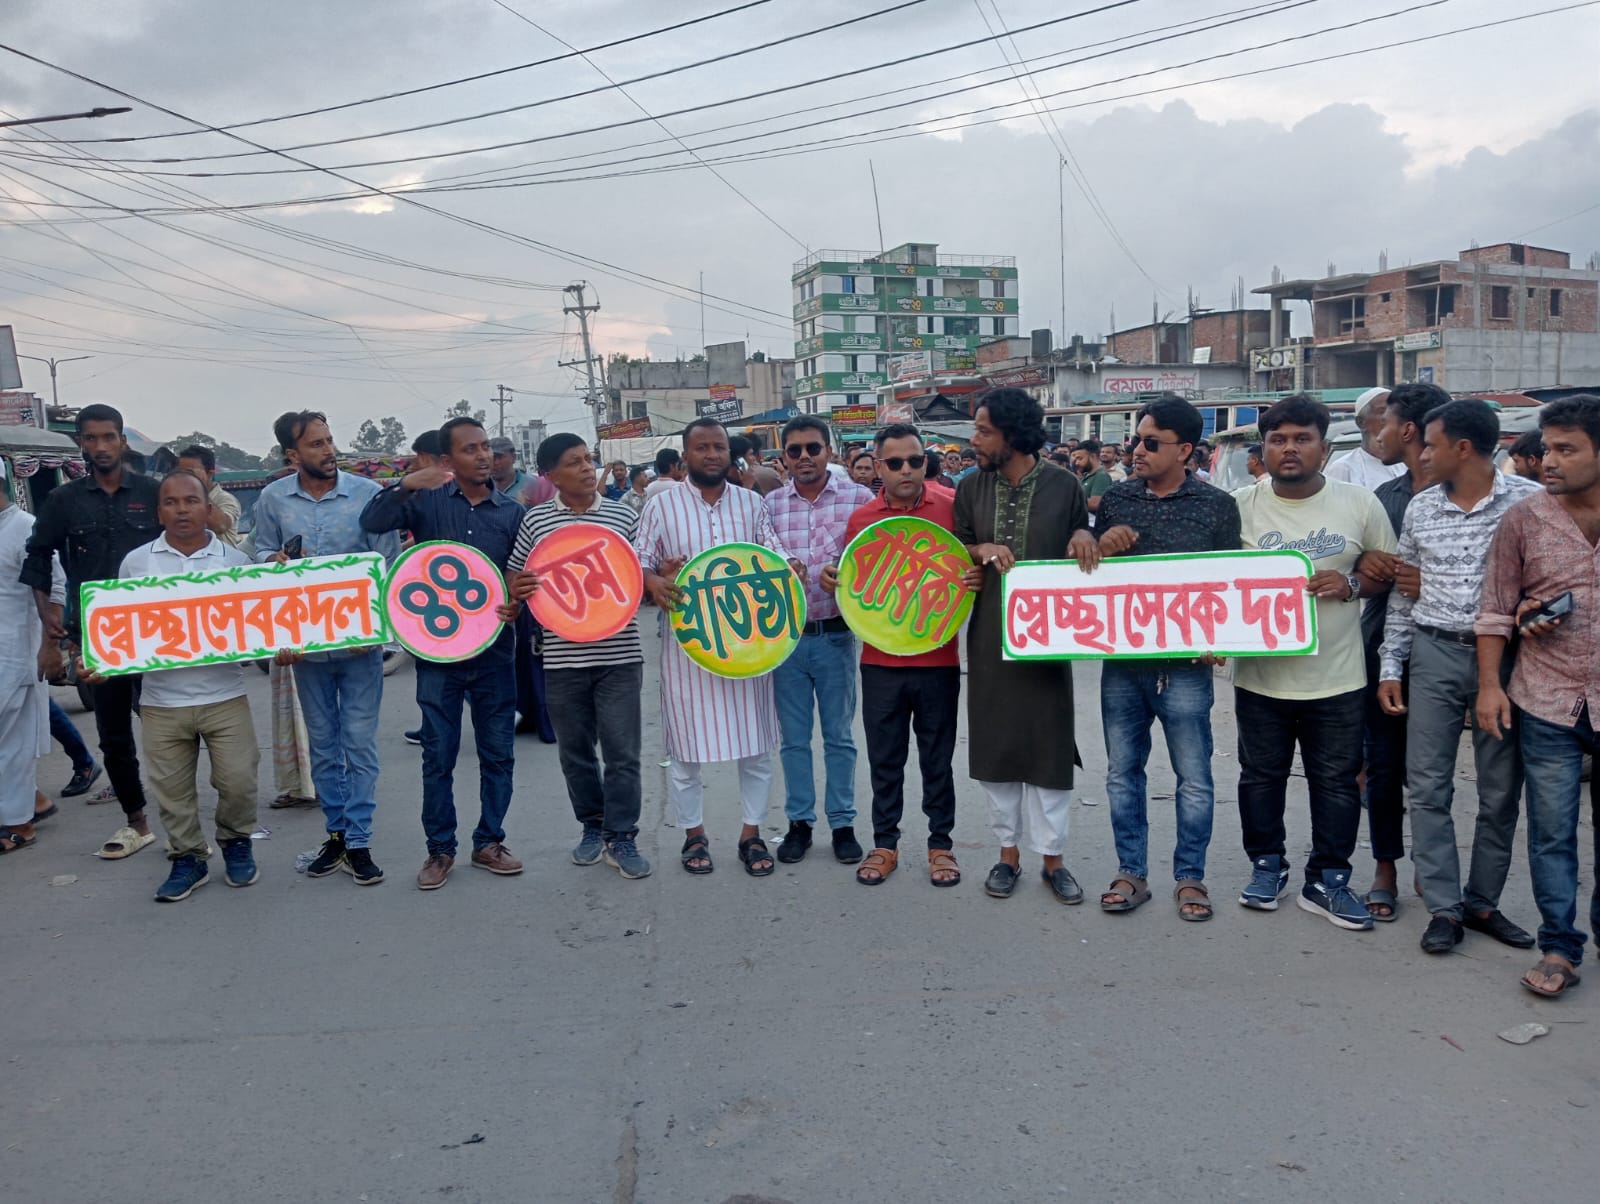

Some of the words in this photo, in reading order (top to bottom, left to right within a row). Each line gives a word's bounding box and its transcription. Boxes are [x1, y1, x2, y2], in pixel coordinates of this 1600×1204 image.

[399, 554, 488, 638] ৪৪
[534, 538, 629, 621] তম
[675, 554, 800, 660] প্রতিষ্ঠা
[1006, 580, 1229, 655] স্বেচ্ছাসেবক
[1233, 575, 1310, 650] দল
